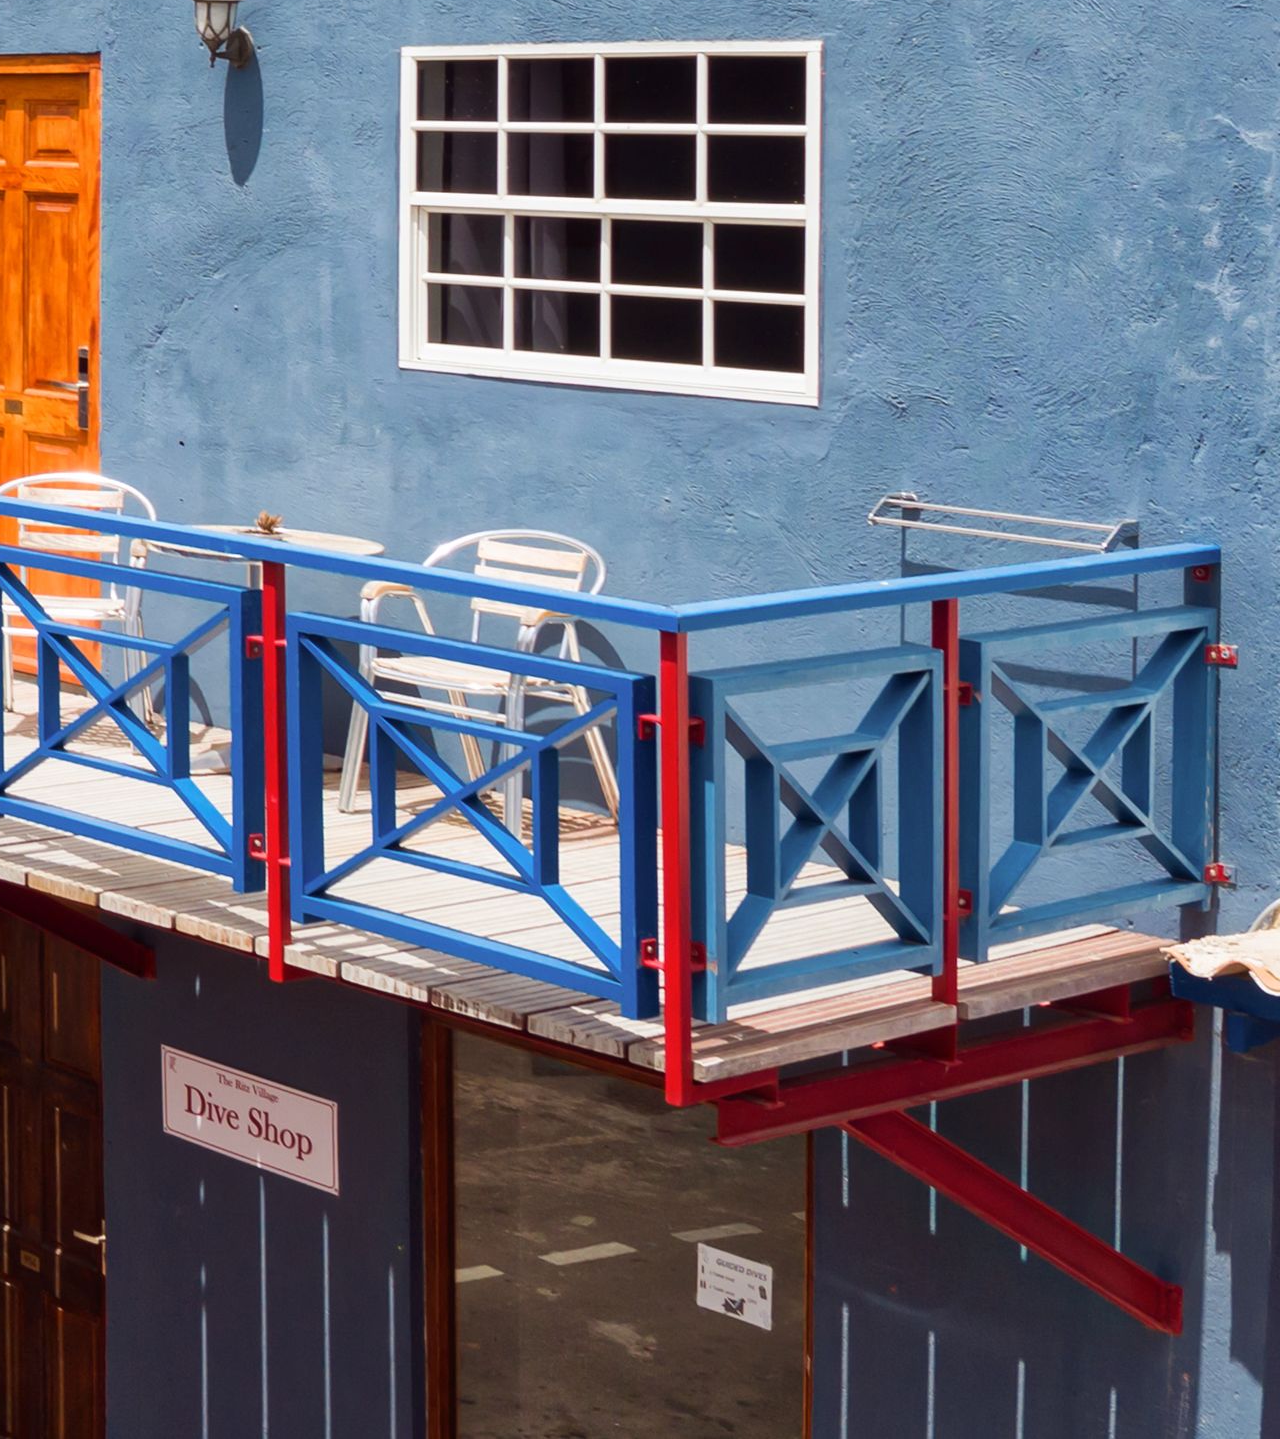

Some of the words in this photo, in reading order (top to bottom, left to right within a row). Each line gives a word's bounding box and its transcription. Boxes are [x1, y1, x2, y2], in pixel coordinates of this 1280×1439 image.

[217, 1073, 233, 1087] The
[252, 1084, 279, 1104] Village
[184, 1083, 240, 1130] Dive
[248, 1107, 313, 1161] Shop
[716, 1258, 745, 1274] GUIDED
[746, 1268, 768, 1282] DIVES
